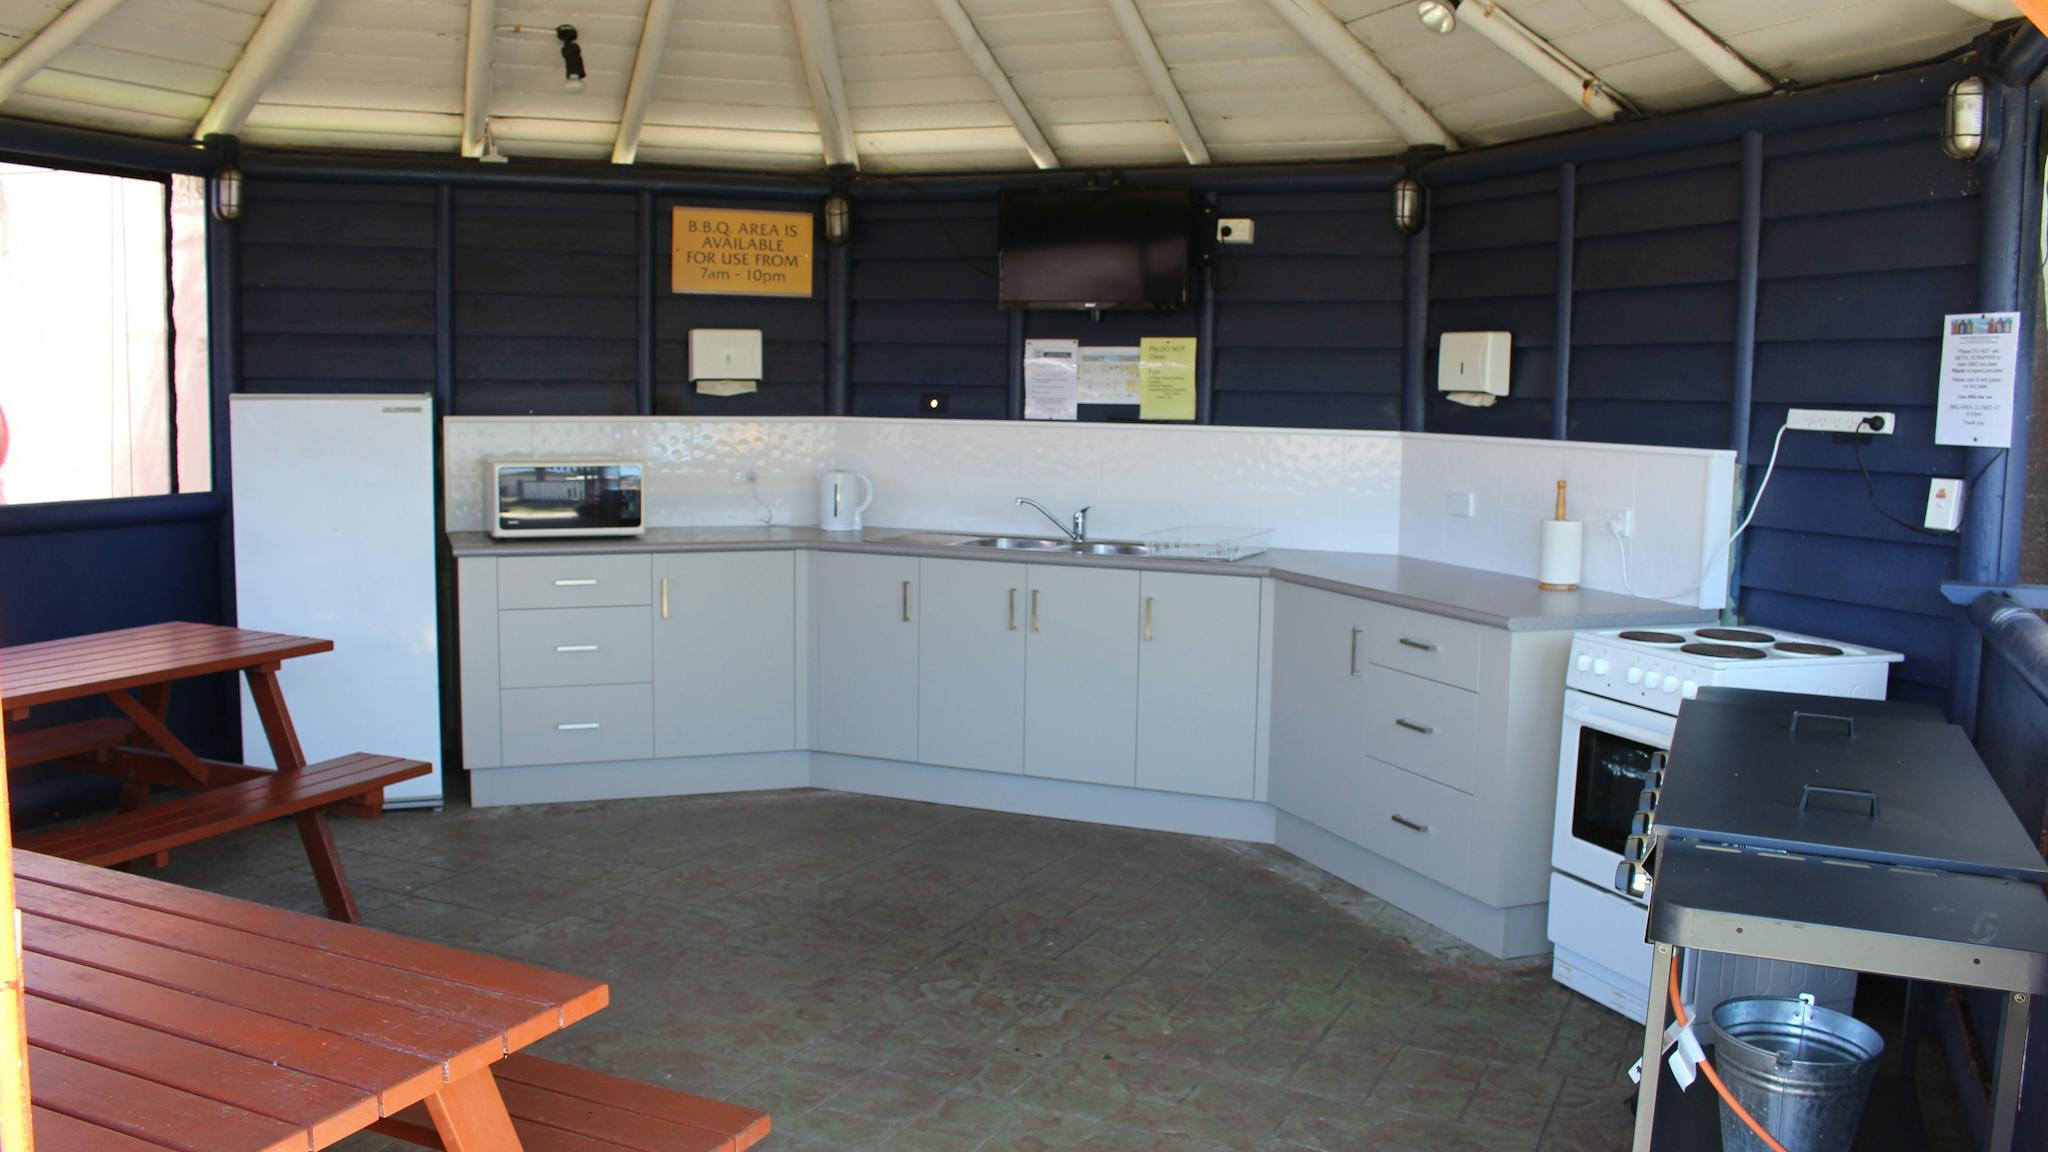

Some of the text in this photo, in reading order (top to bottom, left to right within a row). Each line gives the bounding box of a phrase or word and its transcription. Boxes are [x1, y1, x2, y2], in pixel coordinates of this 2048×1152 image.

[688, 220, 798, 237] B.B.Q. AREA IS
[702, 236, 785, 252] AVAILABLE
[686, 251, 799, 268] FOR USE FROM
[700, 267, 730, 280] 7am
[747, 269, 786, 285] 10pm
